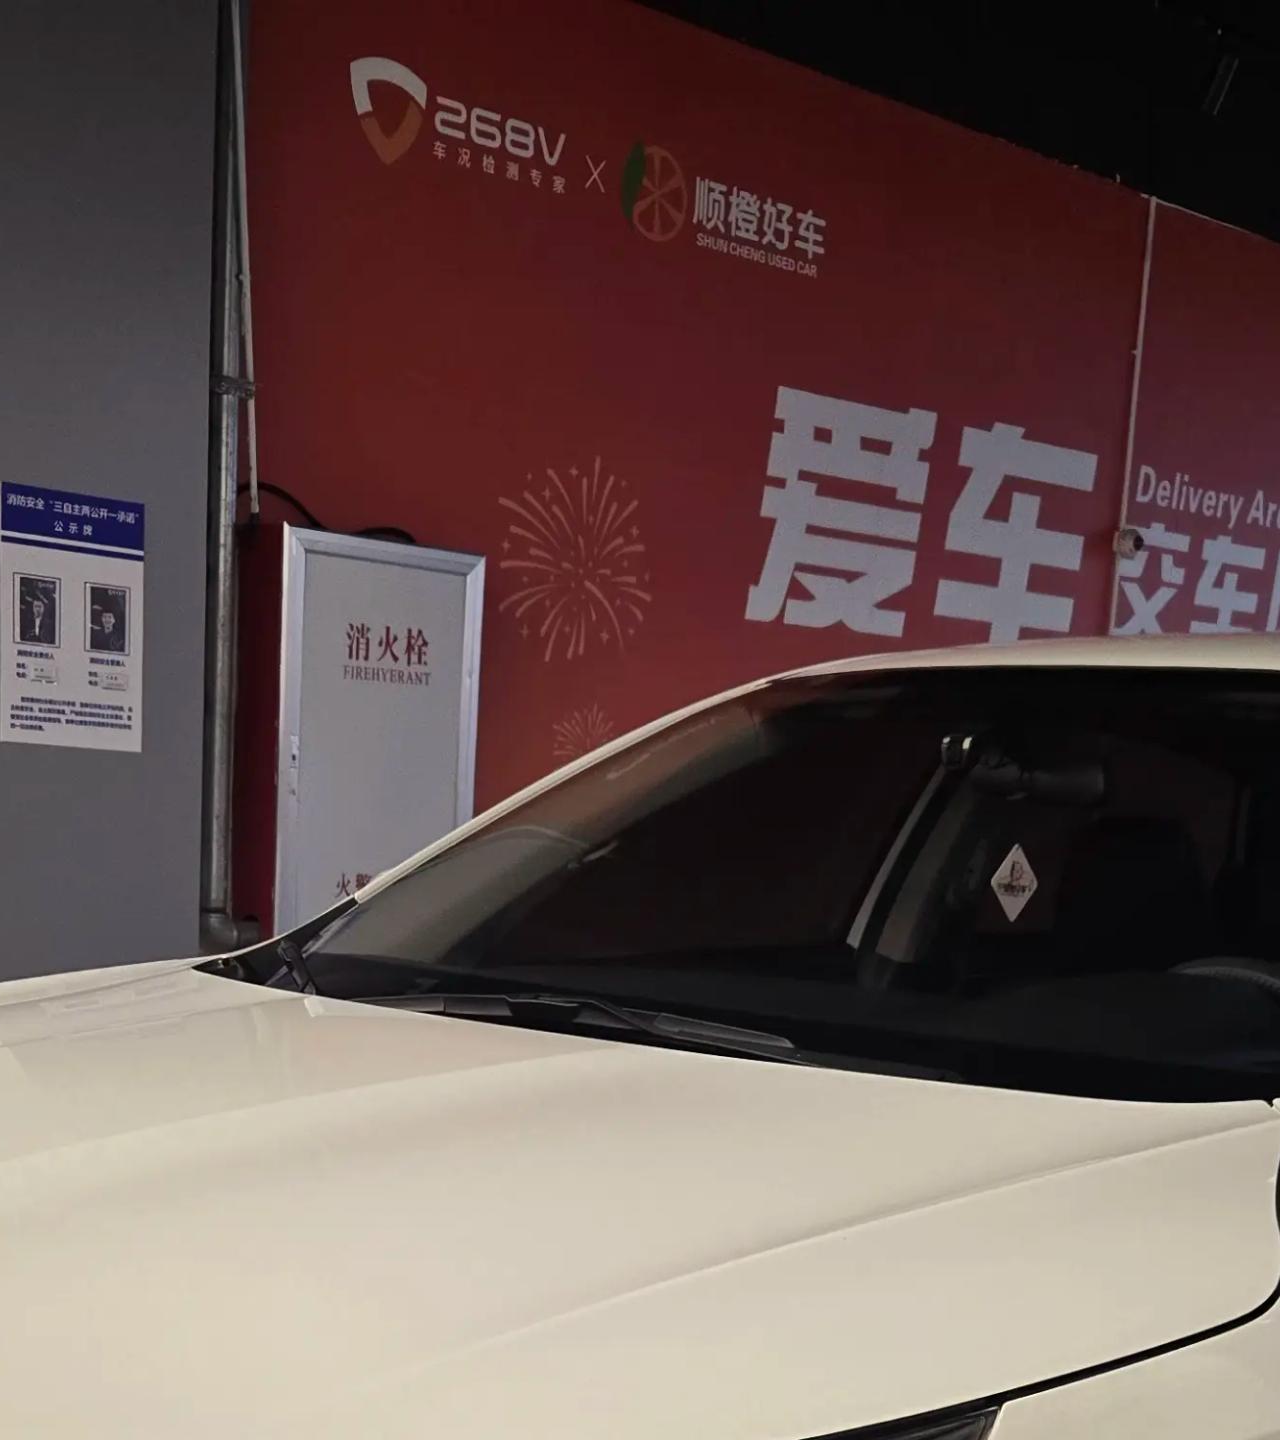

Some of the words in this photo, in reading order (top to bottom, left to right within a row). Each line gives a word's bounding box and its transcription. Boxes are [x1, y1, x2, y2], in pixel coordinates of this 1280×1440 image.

[434, 95, 566, 167] 268V
[432, 140, 566, 194] 车况检测专家
[693, 175, 827, 260] 顺橙好车
[695, 232, 728, 254] SHUN
[729, 242, 766, 263] CHENG
[767, 253, 796, 272] USED
[796, 261, 818, 278] CAR
[6, 492, 45, 510] 消防安全
[745, 385, 1099, 645] 爱车
[1135, 465, 1244, 529] Delivery
[345, 622, 429, 667] 消火栓
